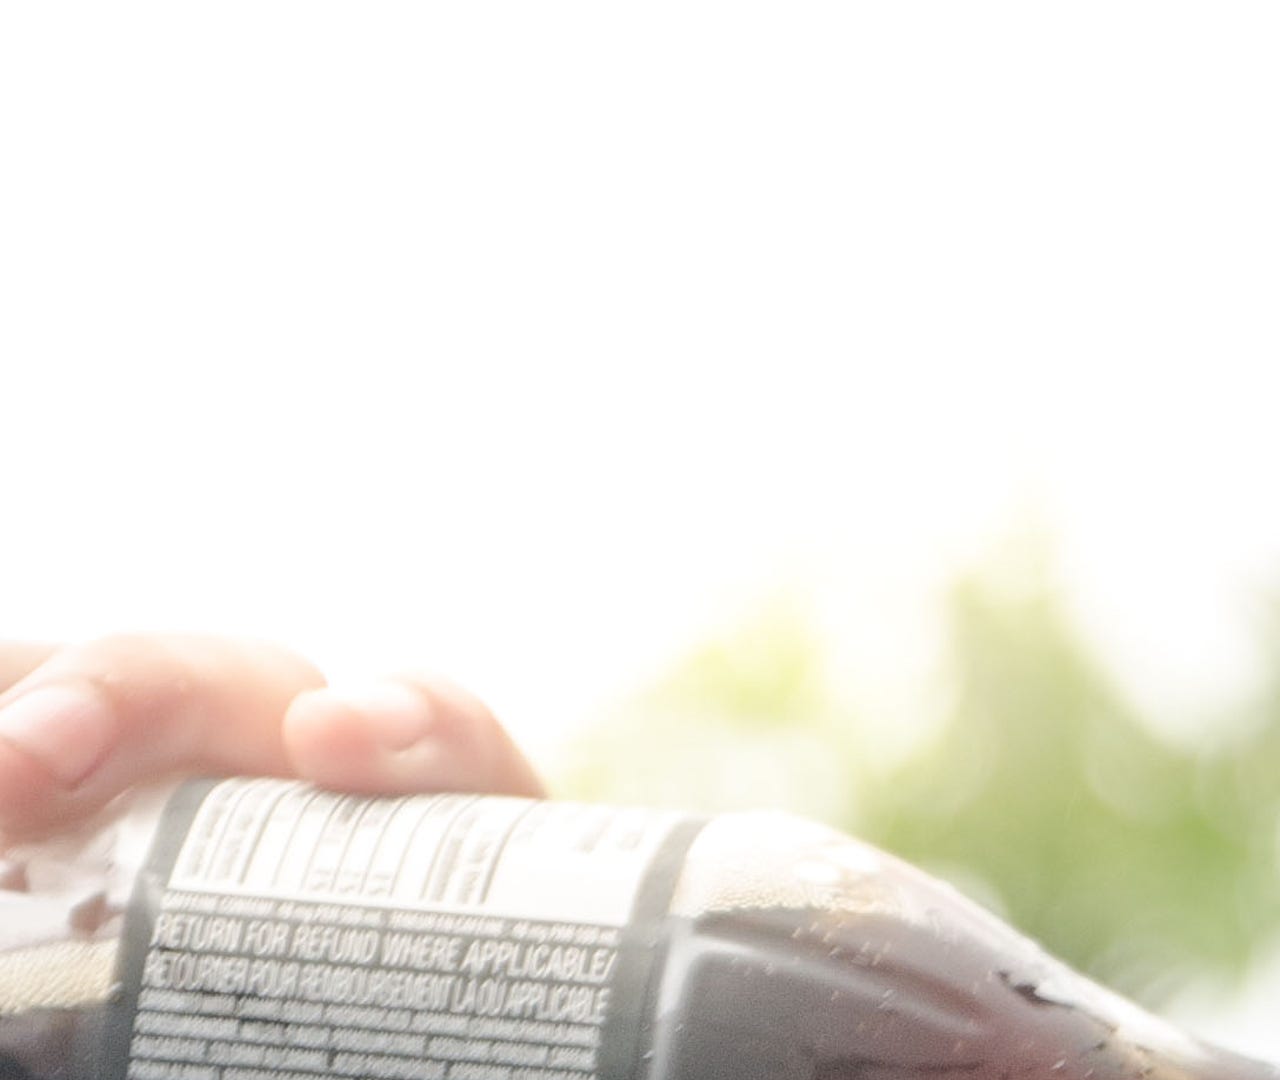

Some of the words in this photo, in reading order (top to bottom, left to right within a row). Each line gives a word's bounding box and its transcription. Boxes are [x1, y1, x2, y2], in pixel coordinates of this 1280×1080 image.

[150, 914, 243, 950] RETURN
[244, 921, 289, 955] FOR
[288, 927, 379, 963] REFUND
[380, 931, 462, 972] WHERE
[141, 950, 250, 996] RETOURNER
[249, 959, 301, 998] POUR
[502, 979, 611, 1024] APPLICABLE
